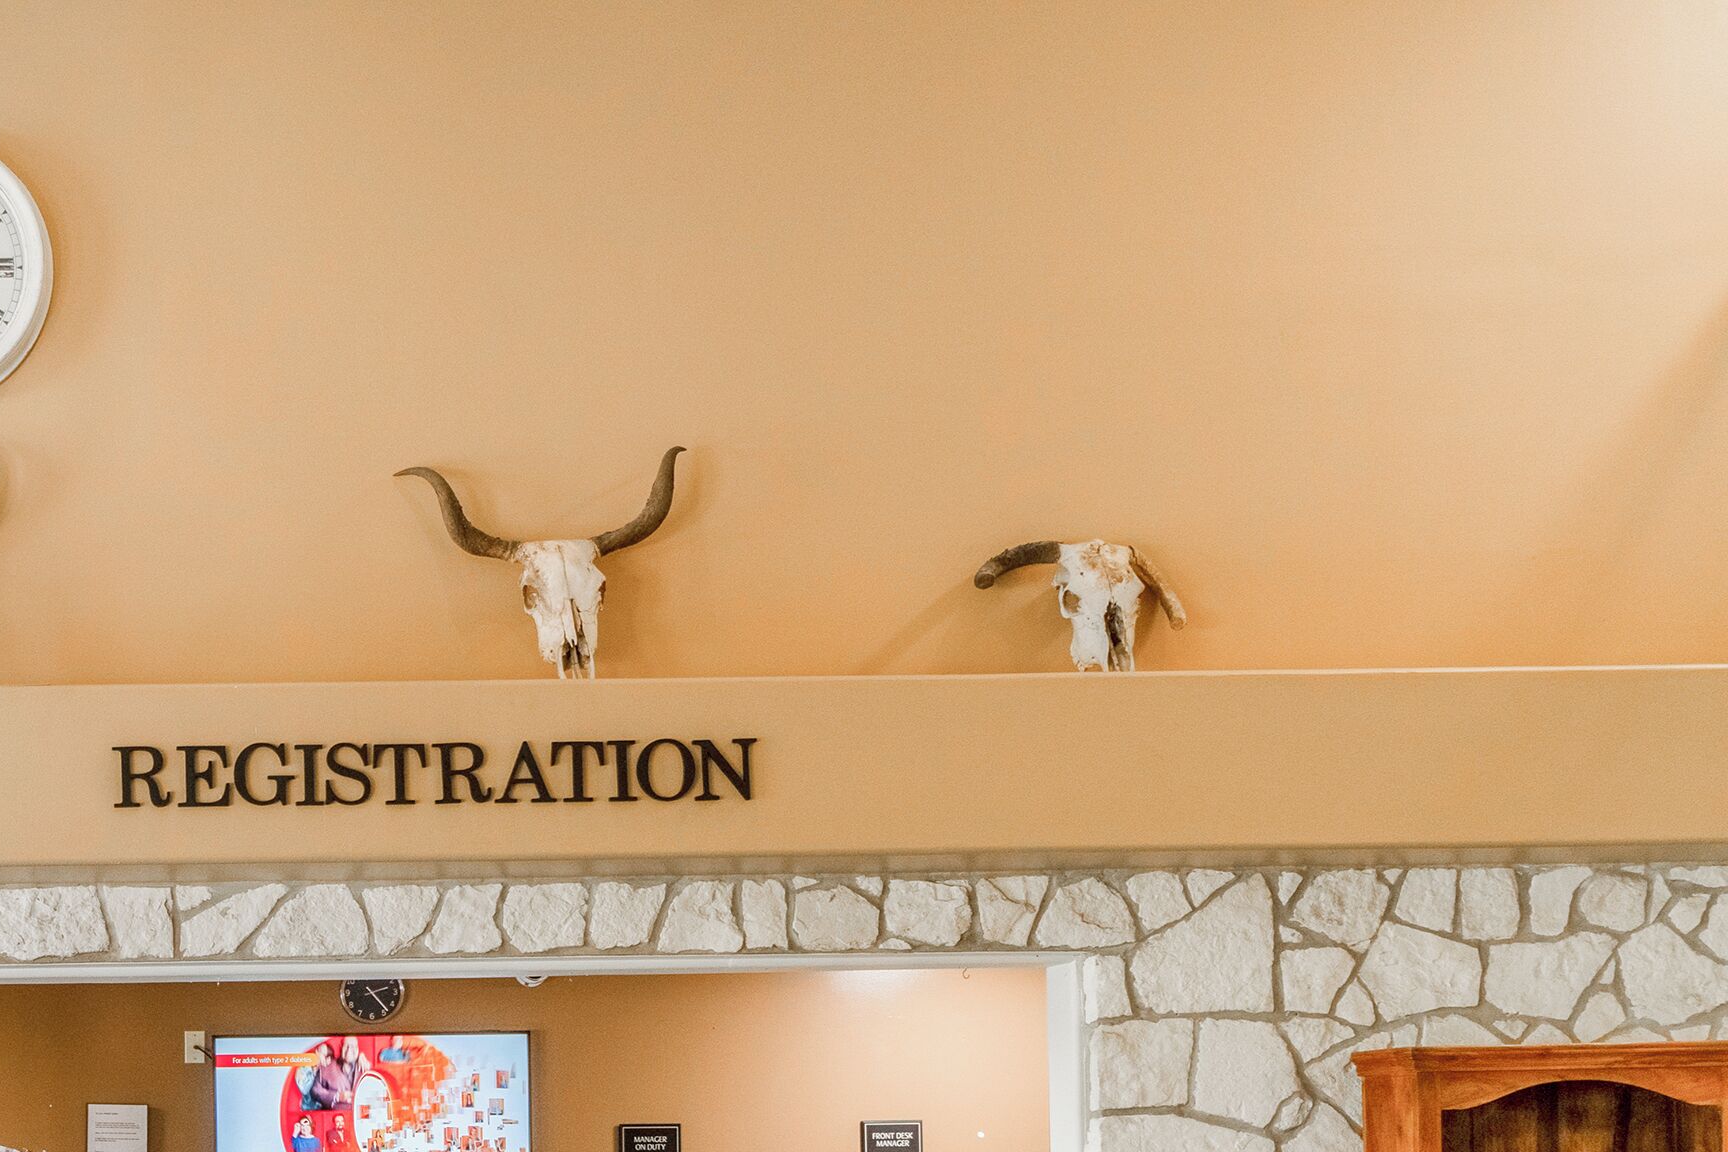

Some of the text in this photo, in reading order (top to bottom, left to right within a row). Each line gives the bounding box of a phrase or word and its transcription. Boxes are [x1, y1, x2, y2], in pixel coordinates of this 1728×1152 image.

[112, 737, 758, 809] REGISTRATION
[345, 989, 351, 997] 9
[393, 988, 398, 996] 3
[369, 1012, 375, 1020] 6
[272, 1057, 284, 1065] type
[872, 1132, 895, 1140] FRONT
